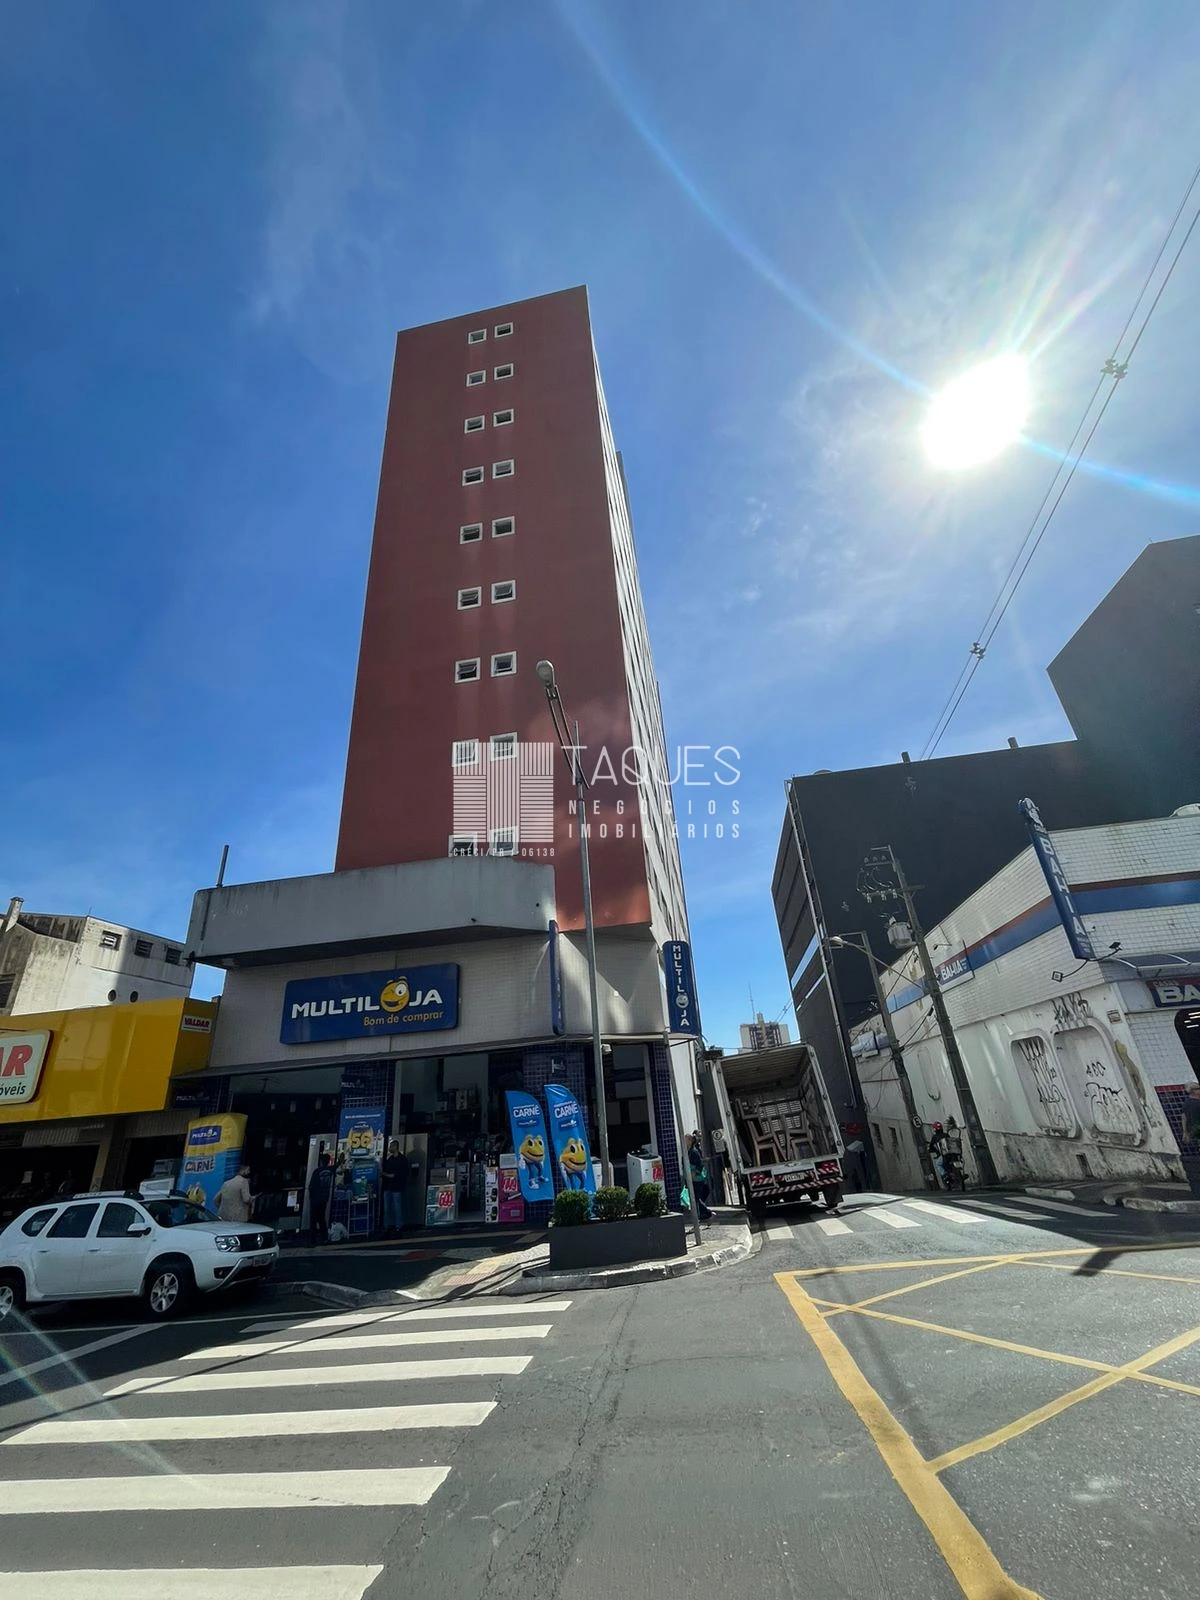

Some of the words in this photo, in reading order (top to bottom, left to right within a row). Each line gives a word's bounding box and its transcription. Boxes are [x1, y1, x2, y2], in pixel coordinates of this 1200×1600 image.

[1039, 836, 1086, 936] BAHIA
[184, 1017, 210, 1028] VALDAR
[363, 1016, 385, 1026] Bom
[387, 1013, 400, 1024] de
[402, 1011, 444, 1023] comprar
